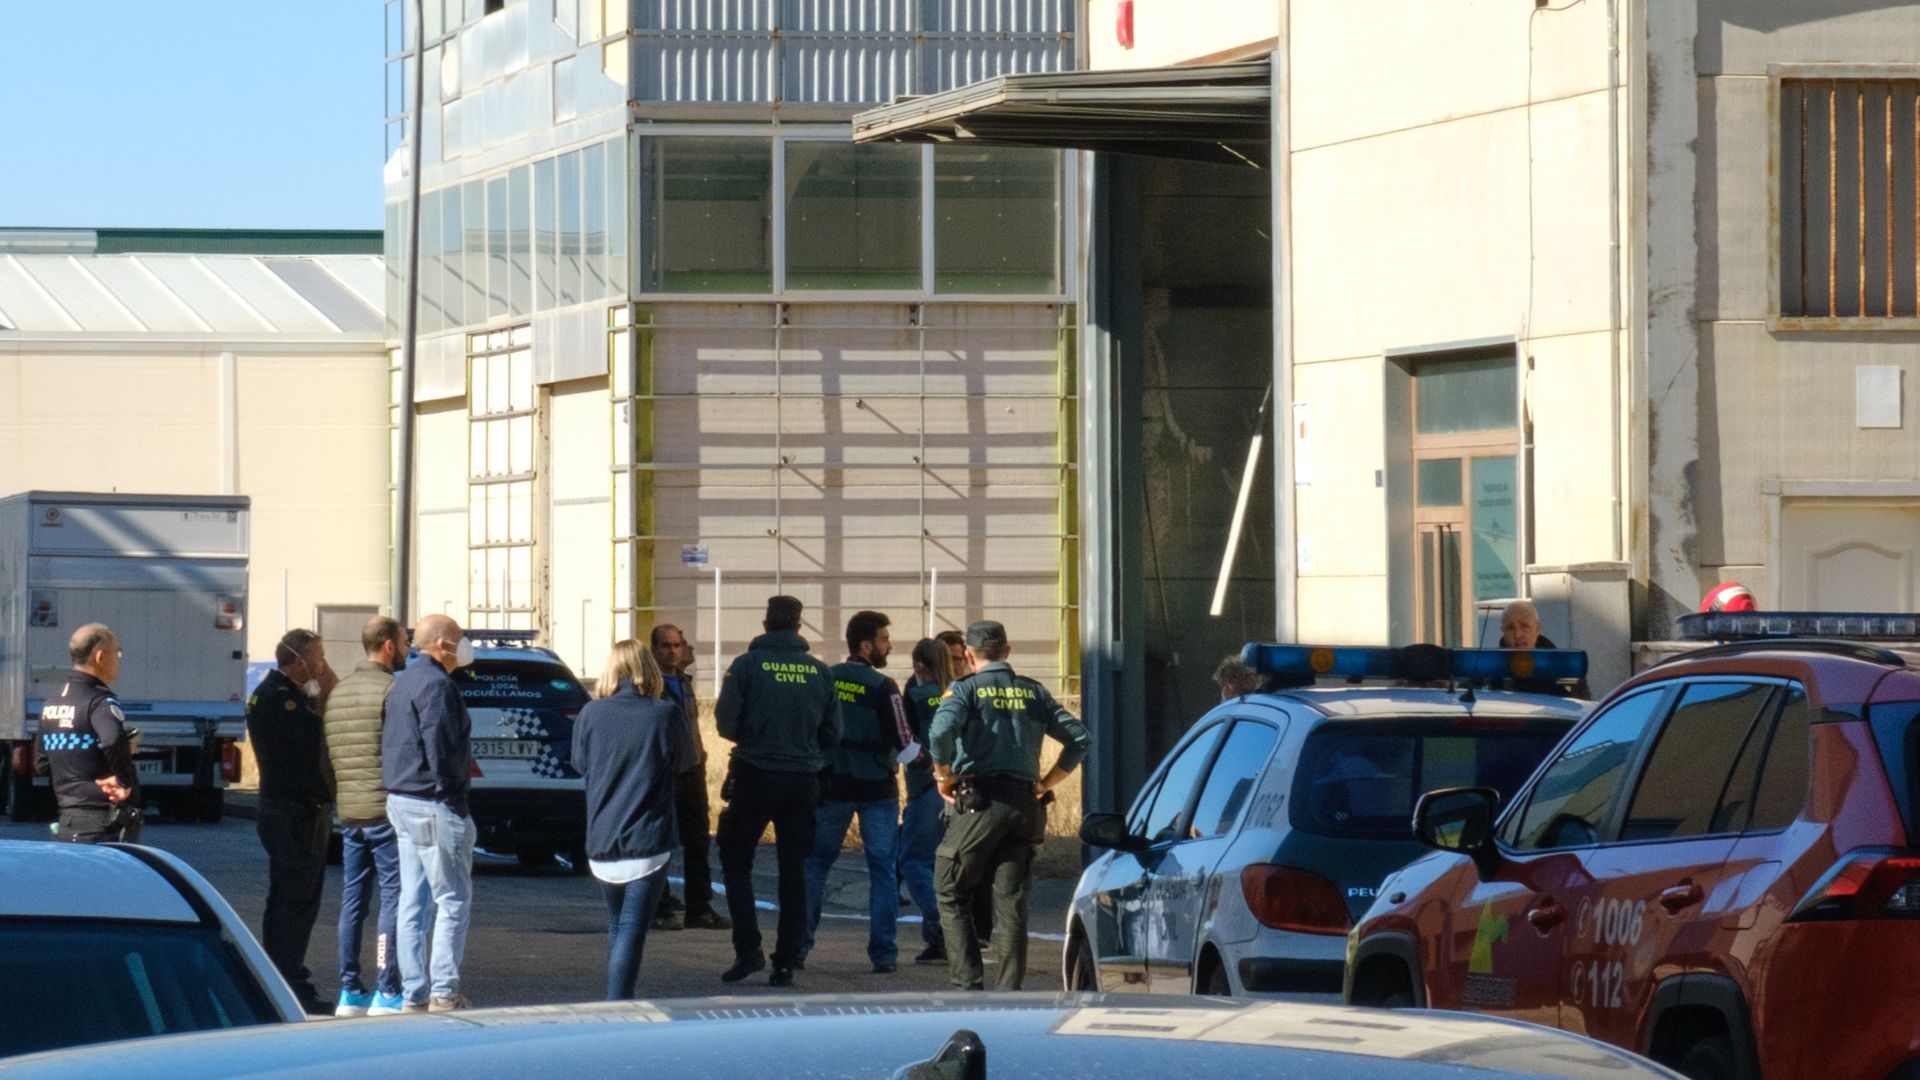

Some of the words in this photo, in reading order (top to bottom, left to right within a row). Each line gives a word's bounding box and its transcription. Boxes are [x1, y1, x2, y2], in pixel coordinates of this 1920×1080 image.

[761, 661, 818, 675] GUARDIA
[775, 672, 807, 684] CIVIL
[977, 687, 1036, 700] GUARDIA
[993, 698, 1026, 710] CIVIL
[472, 742, 505, 755] 2315
[1594, 898, 1646, 946] 1006
[1589, 960, 1624, 1009] 112
